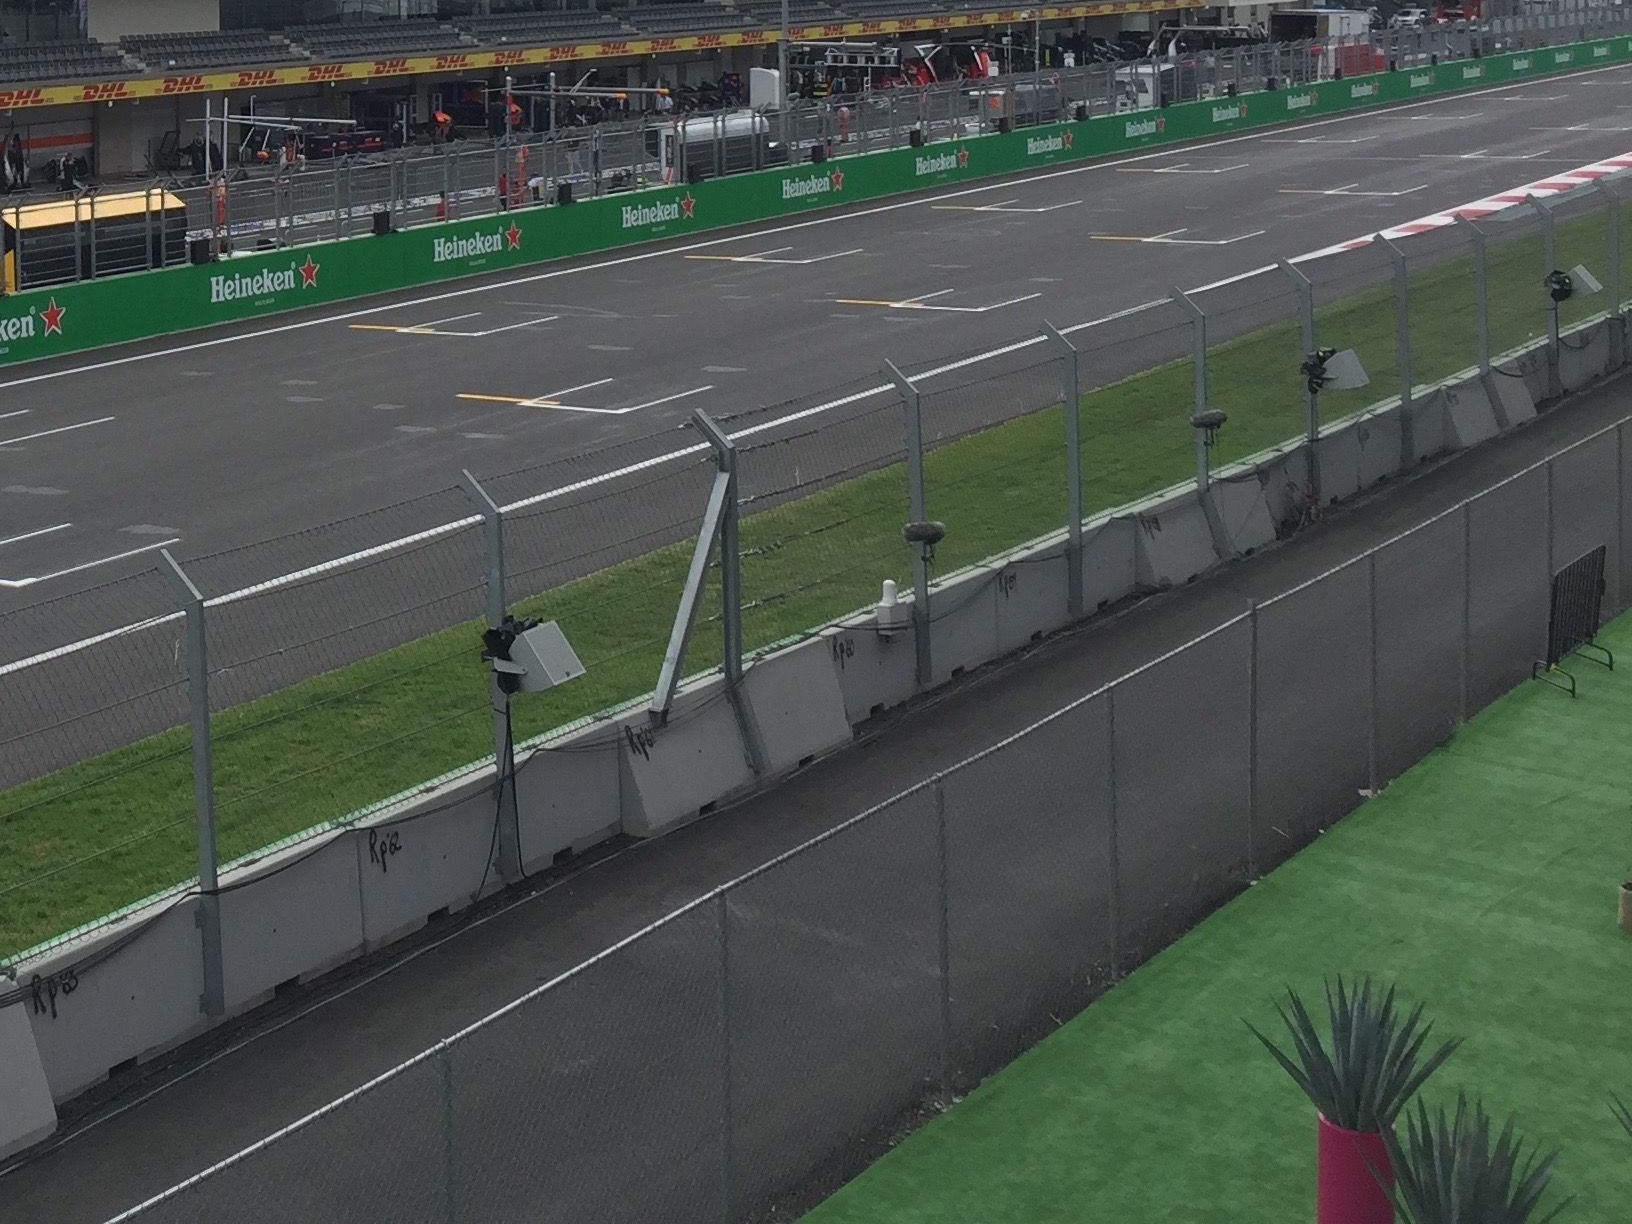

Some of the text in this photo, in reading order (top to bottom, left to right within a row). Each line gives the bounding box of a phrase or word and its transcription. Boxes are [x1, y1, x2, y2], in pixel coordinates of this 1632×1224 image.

[374, 59, 412, 75] DHL
[435, 55, 468, 69] DHL
[238, 71, 279, 86] DHL
[307, 65, 346, 81] DHL
[82, 82, 128, 100] DHL
[163, 76, 206, 93] DHL
[1027, 133, 1062, 155] Heineken
[915, 152, 958, 176] Heineken
[782, 172, 830, 199] Heineken
[622, 200, 679, 228] Heineken
[433, 232, 502, 262] Heineken
[210, 267, 296, 303] Heineken
